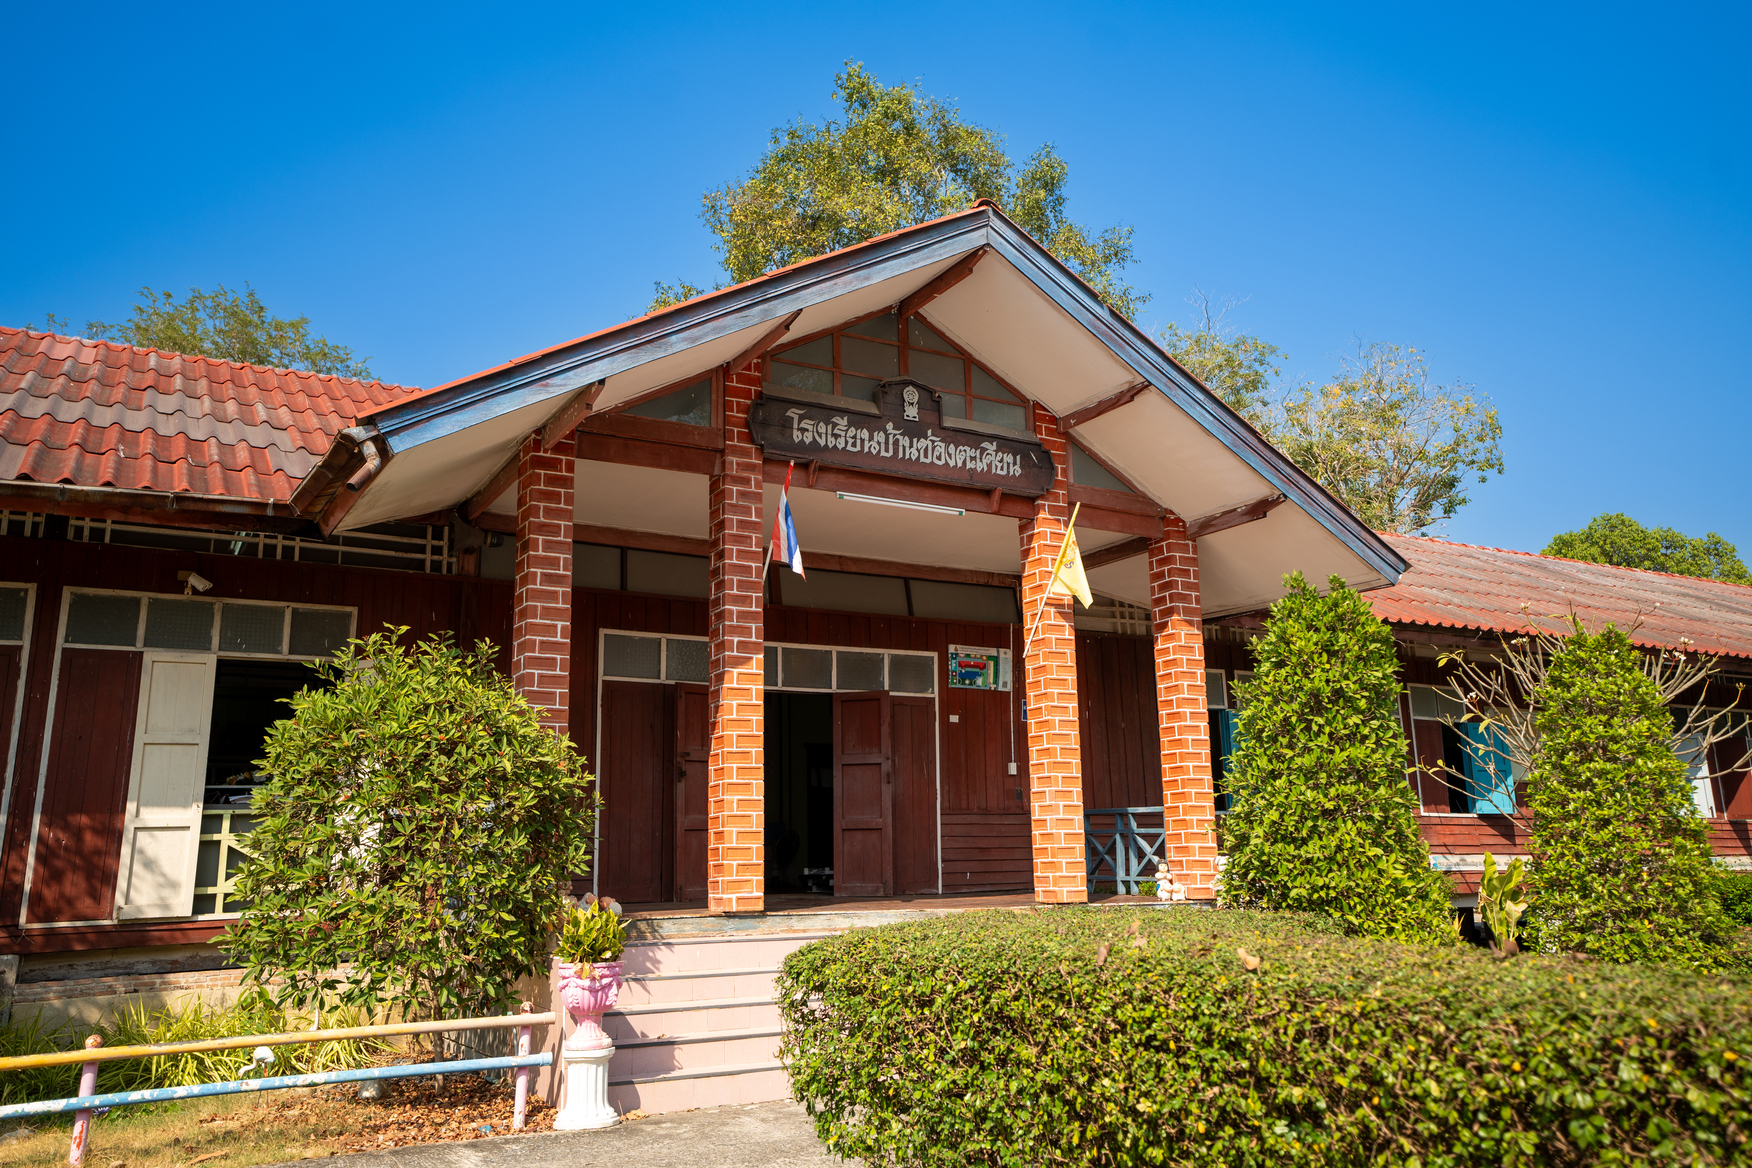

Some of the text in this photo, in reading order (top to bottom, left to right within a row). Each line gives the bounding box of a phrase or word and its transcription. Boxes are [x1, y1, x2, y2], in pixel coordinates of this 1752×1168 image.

[785, 408, 1021, 477] โรงเรียนบ้านช่องตะเคียน
